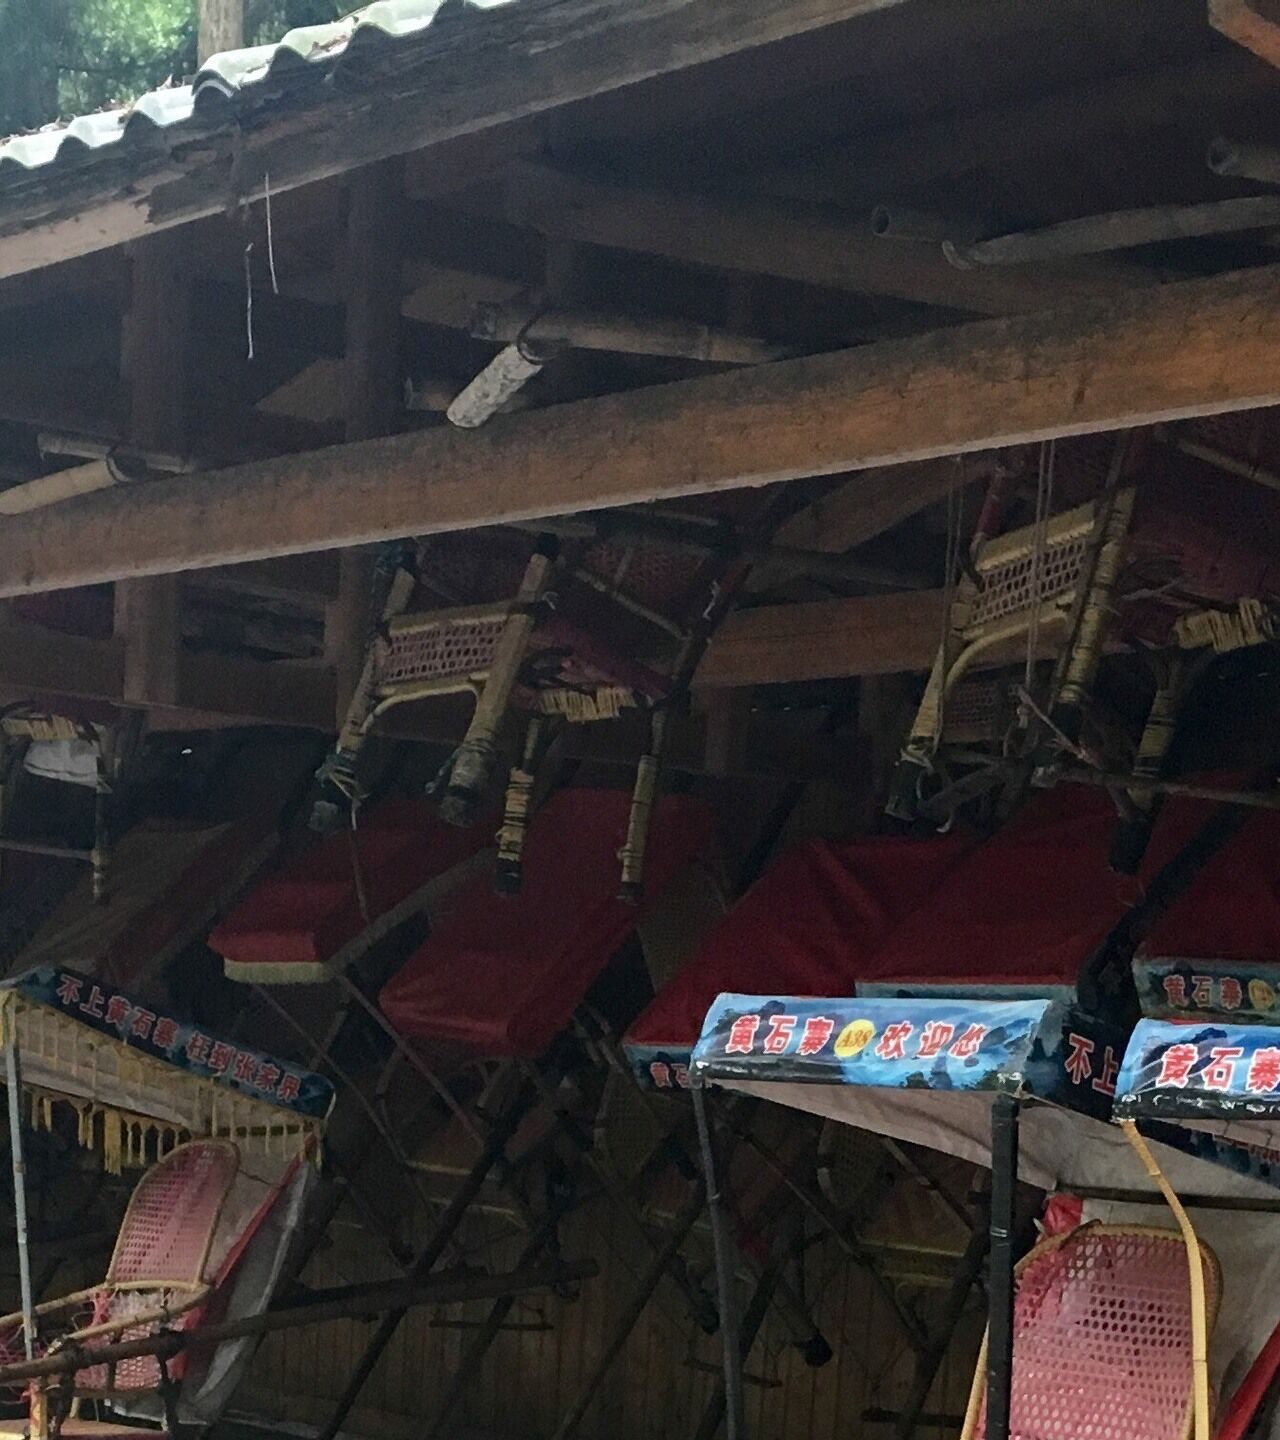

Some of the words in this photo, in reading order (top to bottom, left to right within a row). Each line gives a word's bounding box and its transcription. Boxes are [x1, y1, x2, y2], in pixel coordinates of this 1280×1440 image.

[1162, 974, 1242, 1010] 黄石寨
[56, 973, 179, 1048] 不上黄石寨
[186, 1030, 301, 1103] 枉到张家界
[725, 1014, 835, 1056] 黄石寨
[1064, 1032, 1120, 1097] 不上
